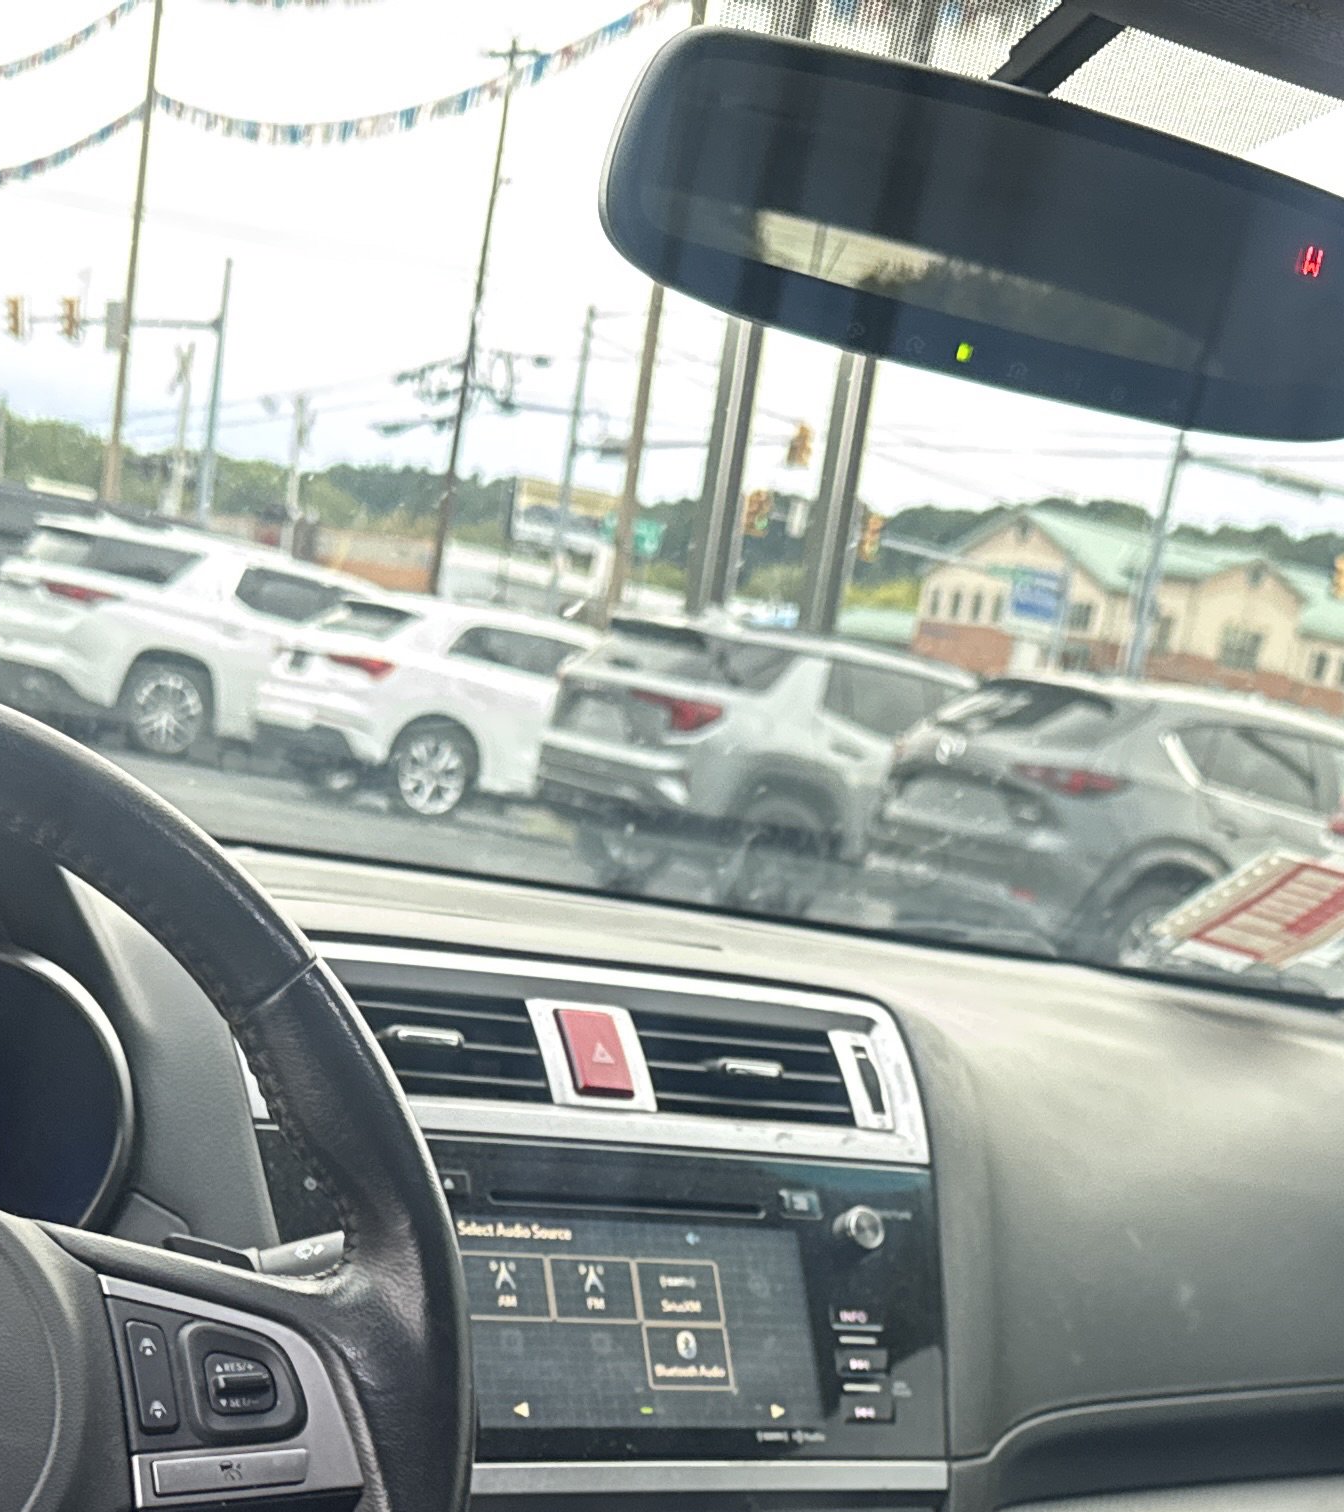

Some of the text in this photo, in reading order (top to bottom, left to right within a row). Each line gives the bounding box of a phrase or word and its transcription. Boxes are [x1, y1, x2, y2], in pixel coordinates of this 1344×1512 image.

[457, 1220, 573, 1241] Select Audio Source
[839, 1309, 869, 1324] INFO
